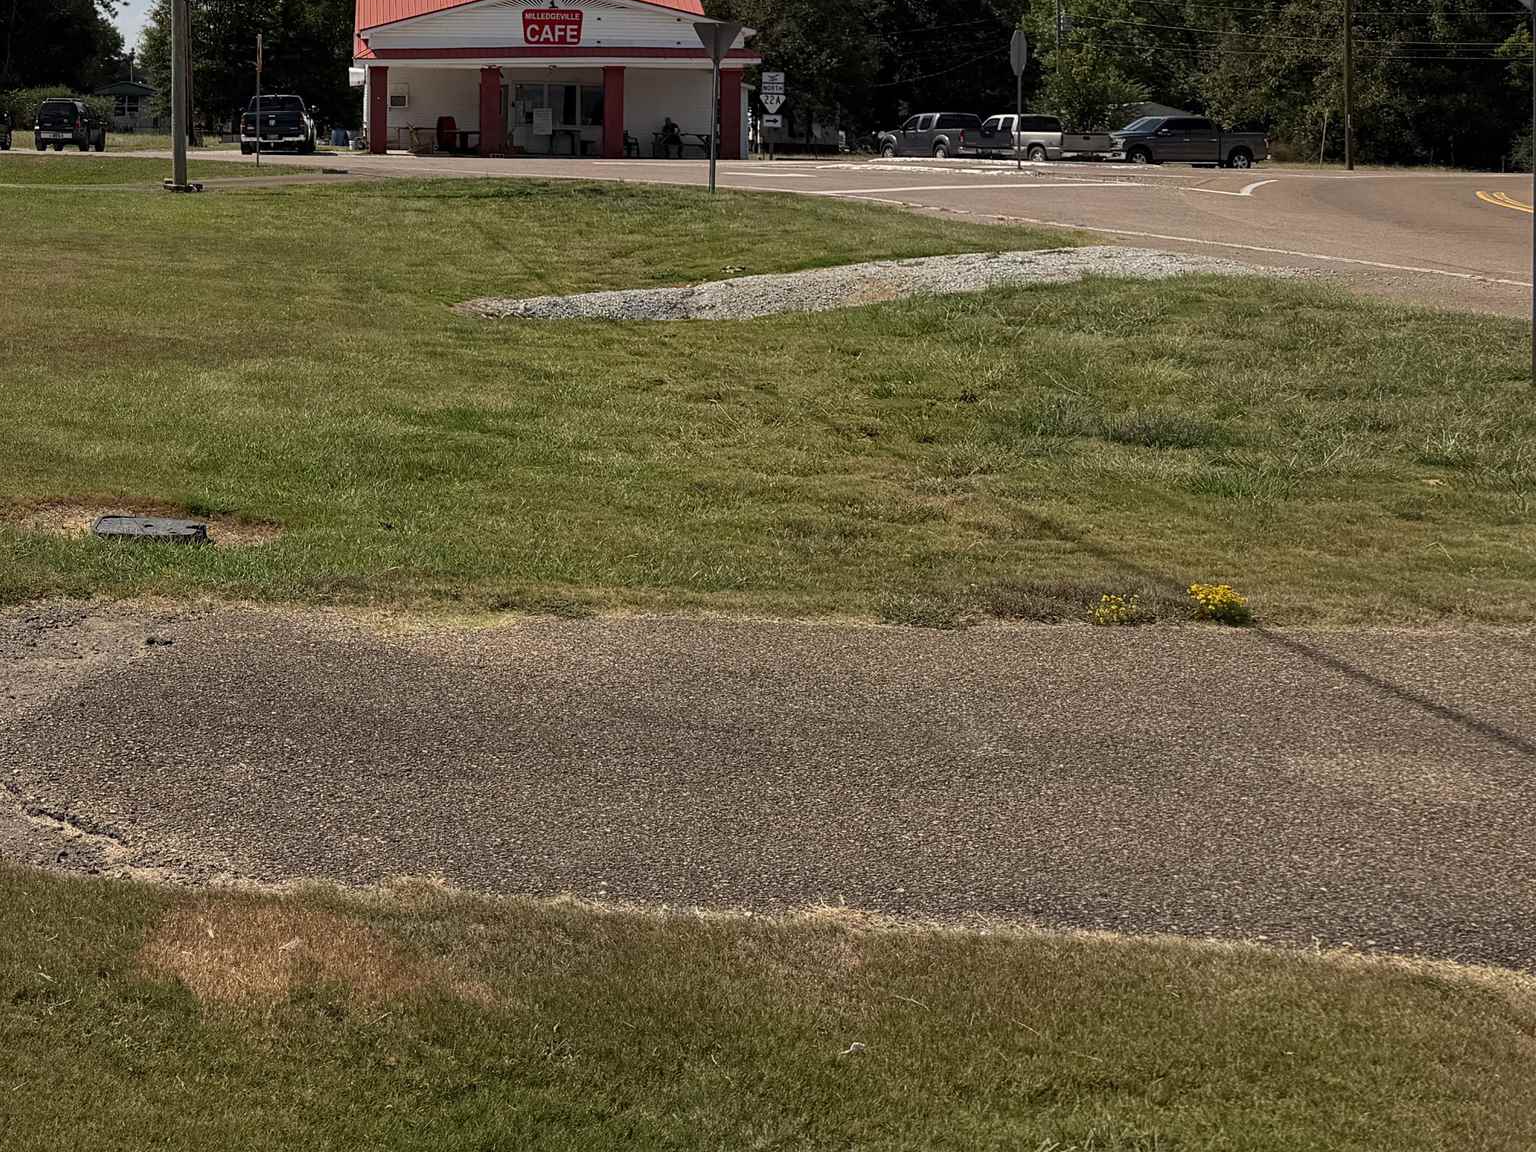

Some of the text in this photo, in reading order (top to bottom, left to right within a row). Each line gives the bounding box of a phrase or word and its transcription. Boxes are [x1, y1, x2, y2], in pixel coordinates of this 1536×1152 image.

[525, 12, 580, 20] MILLEDGEVILLE
[526, 24, 578, 43] CAFE
[764, 95, 781, 105] 22A
